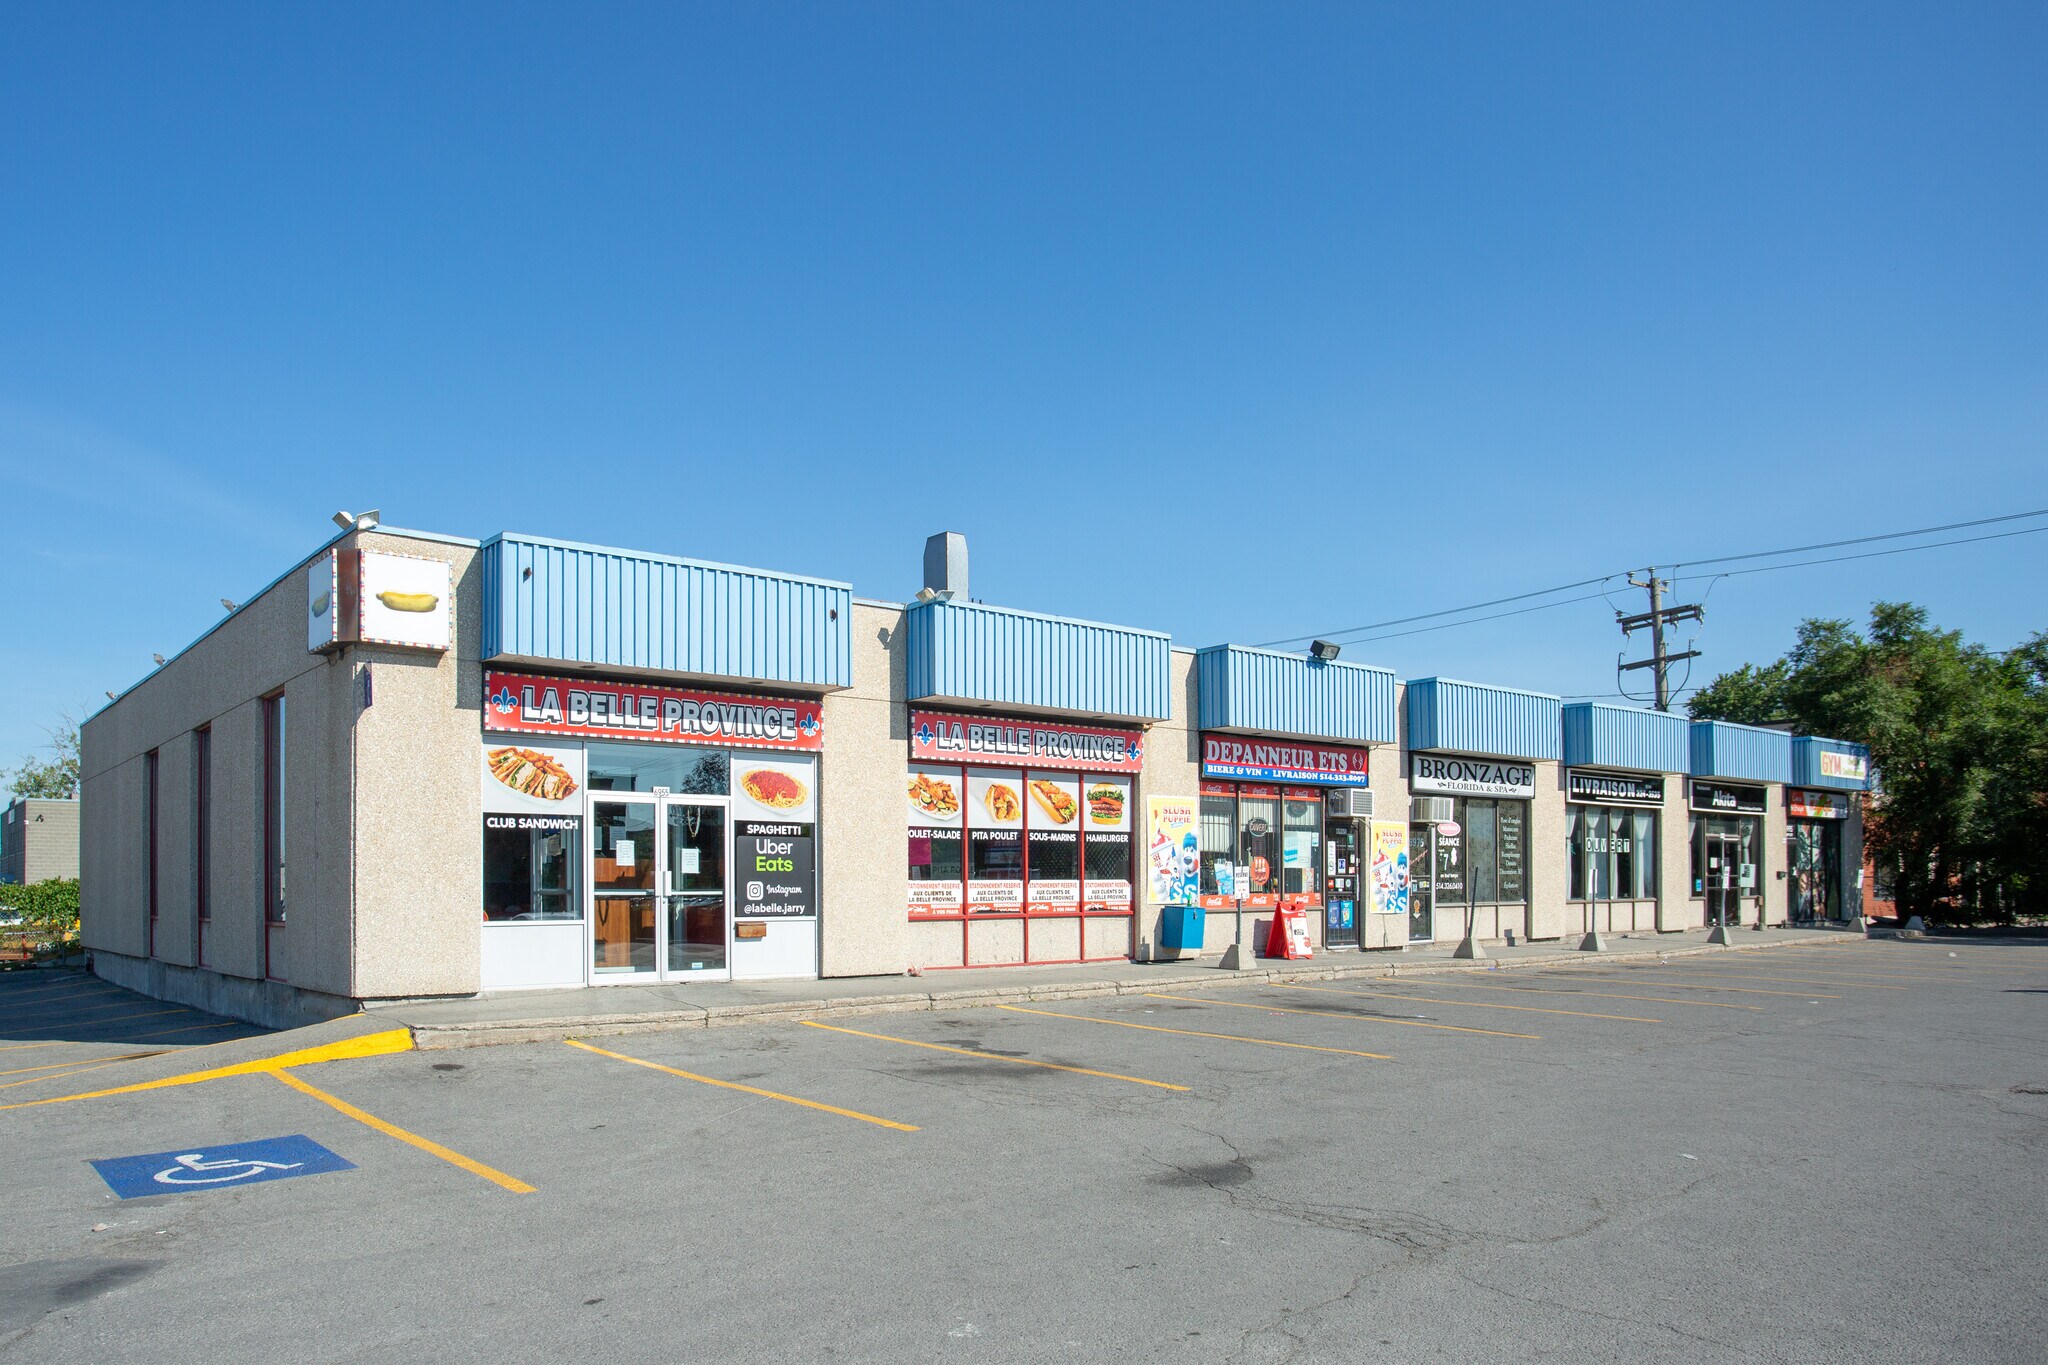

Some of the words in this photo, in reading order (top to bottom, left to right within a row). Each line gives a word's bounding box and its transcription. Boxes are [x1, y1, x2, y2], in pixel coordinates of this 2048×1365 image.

[521, 685, 562, 724] LA
[568, 689, 658, 731] BELLE
[662, 696, 797, 741] PROVINCE
[936, 721, 965, 750] LA
[968, 725, 1030, 754] BELLE
[1034, 730, 1125, 762] PROVINCE
[1206, 740, 1314, 770] DEPANNEUR
[1318, 751, 1348, 772] ETS
[1822, 754, 1841, 775] GYM
[1207, 765, 1235, 775] BIERE
[1236, 767, 1244, 775] &
[1246, 768, 1262, 776] VIN
[1273, 770, 1318, 780] LIVRAISON
[1418, 758, 1532, 786] BRONZAGE
[654, 788, 669, 796] 6955
[1447, 782, 1484, 791] FLORIDA
[1572, 777, 1635, 798] LIVRAISON
[1712, 790, 1737, 807] Akita
[1163, 806, 1191, 815] SLUSH
[487, 817, 516, 828] CLUB
[519, 818, 579, 830] SANDWICH
[1163, 815, 1191, 823] PUPPIE
[747, 824, 801, 836] SPAGHETTI
[908, 829, 961, 839] OULET-SALADE
[971, 831, 988, 840] PITA
[990, 831, 1018, 840] POULET
[1029, 832, 1076, 842] SOUS-MARINS
[1086, 833, 1129, 843] HAMBURGER
[1439, 836, 1460, 846] SÉANCE
[756, 839, 793, 855] Uber
[1586, 838, 1630, 852] OUVERT
[756, 856, 794, 872] Eats
[766, 884, 802, 897] Instagram
[744, 903, 805, 915] @labelle.jarry
